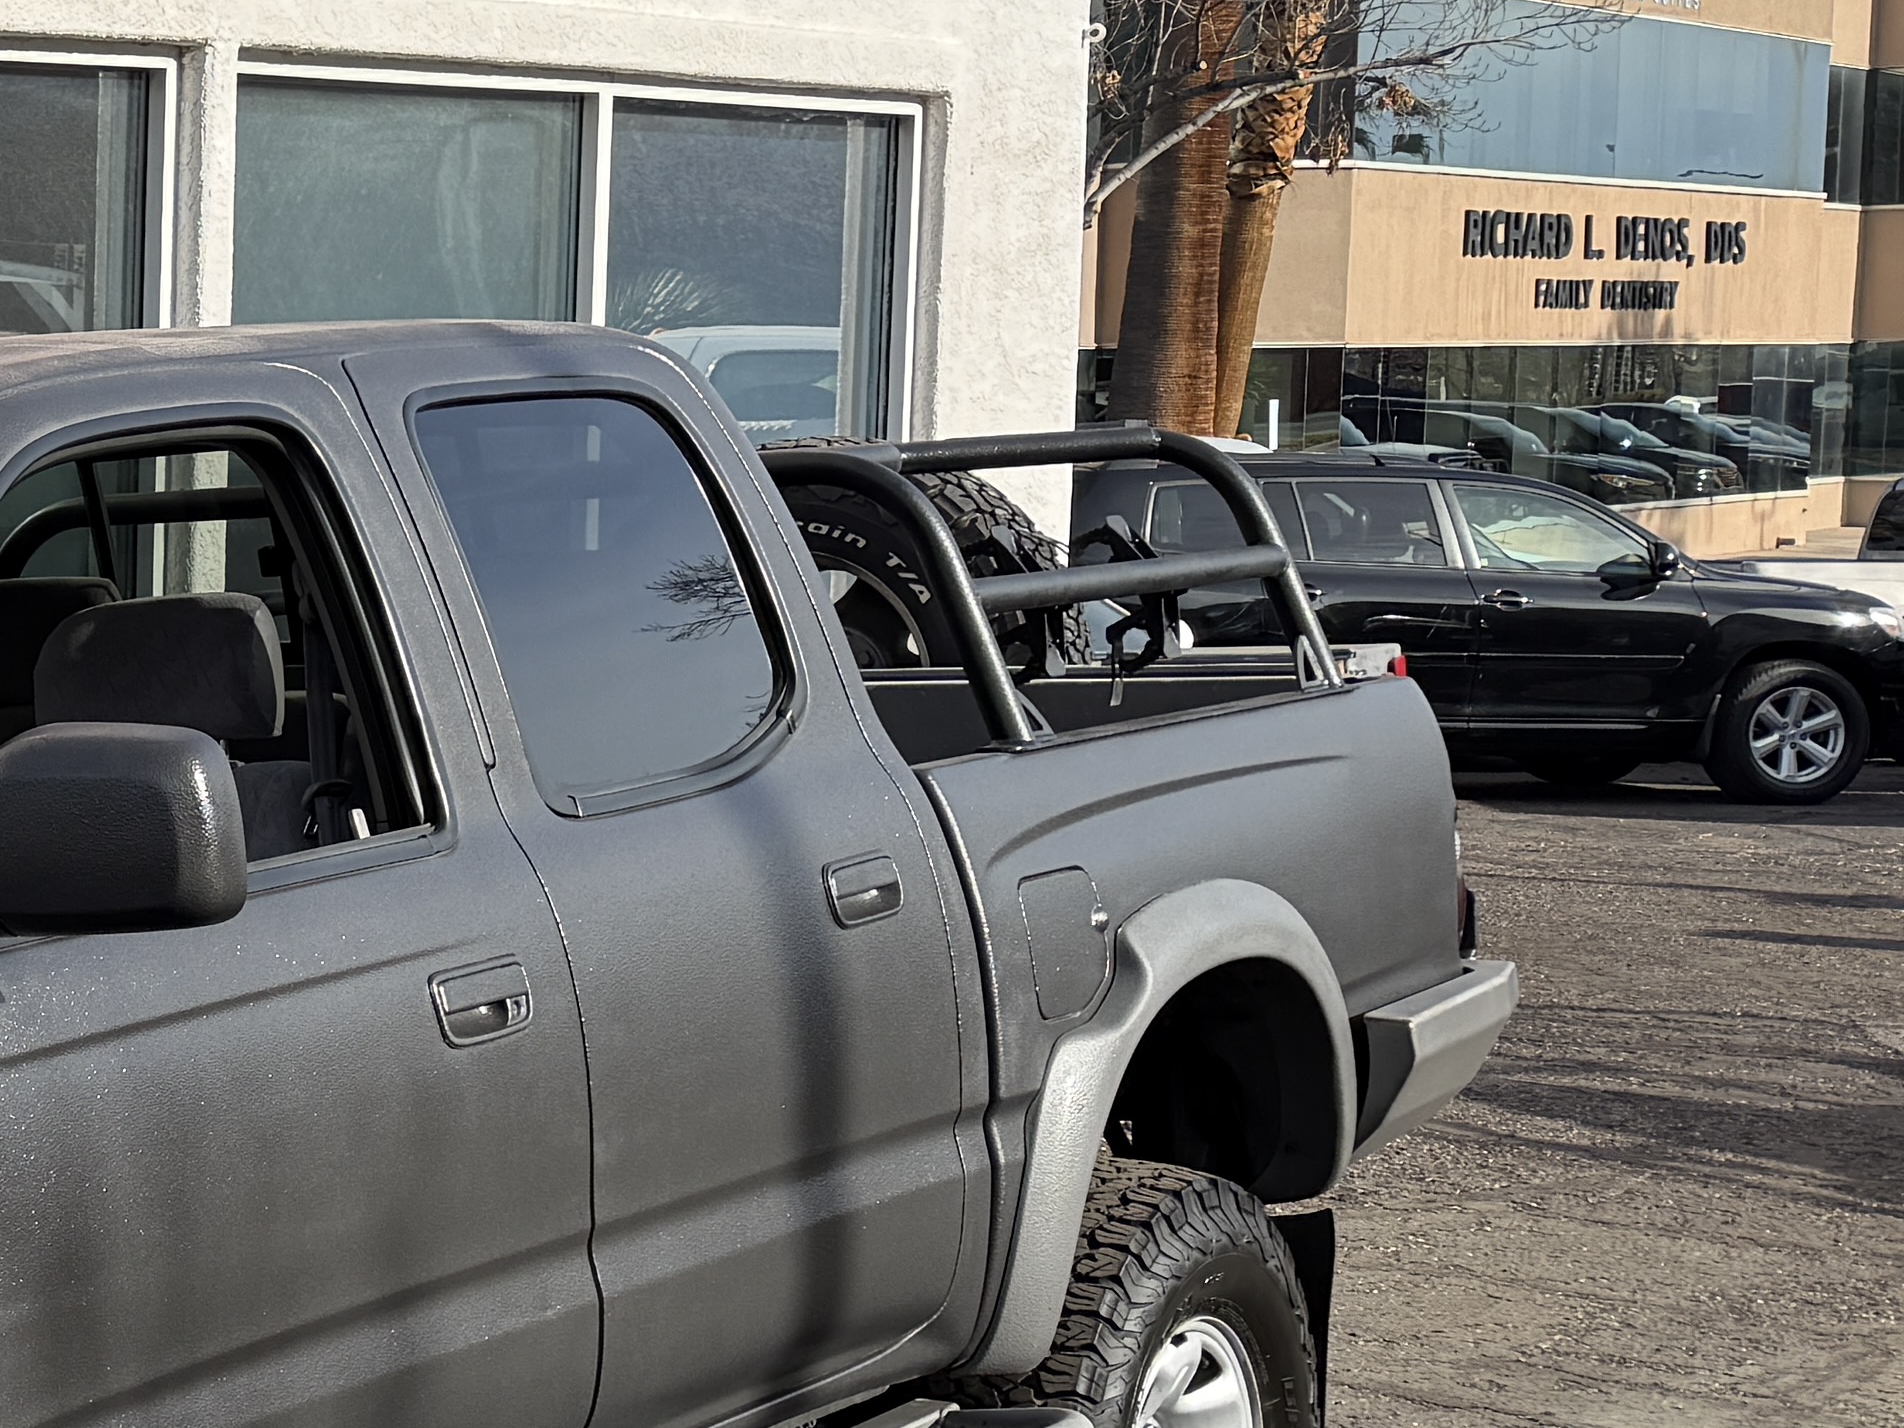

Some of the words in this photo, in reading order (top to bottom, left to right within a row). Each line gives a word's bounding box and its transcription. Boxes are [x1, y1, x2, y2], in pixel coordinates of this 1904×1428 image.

[1462, 209, 1574, 260] RICHARD
[1583, 214, 1605, 260] L.
[1615, 215, 1696, 269] DENOS,
[1704, 221, 1748, 264] DDS
[1534, 278, 1594, 309] FAMILY
[1600, 280, 1680, 310] DENTISTRY
[885, 551, 932, 604] T/A
